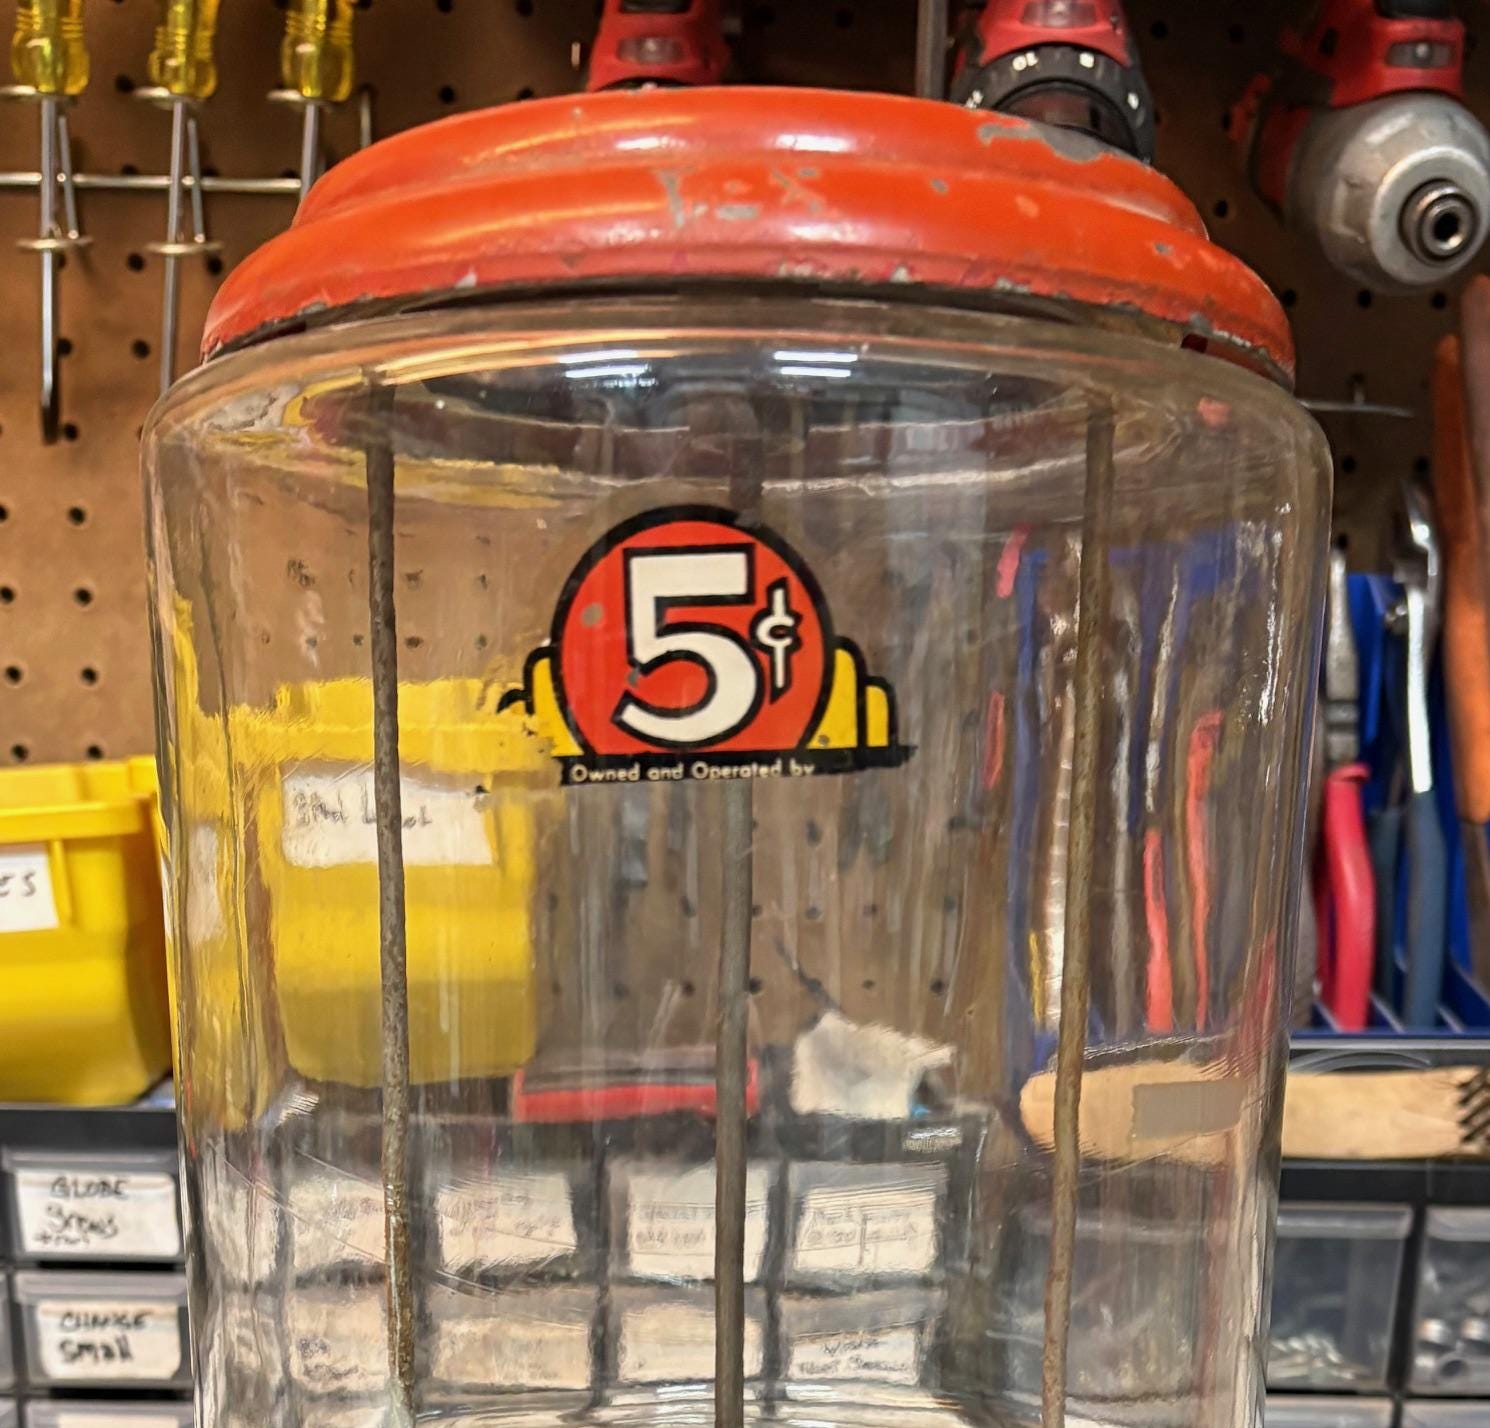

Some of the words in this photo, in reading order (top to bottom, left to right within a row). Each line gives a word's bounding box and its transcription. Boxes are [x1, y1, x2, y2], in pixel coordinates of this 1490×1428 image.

[570, 763, 641, 784] Owned
[647, 762, 684, 781] and
[692, 757, 782, 781] Operated
[789, 757, 815, 777] by
[51, 1176, 129, 1199] GLOBE
